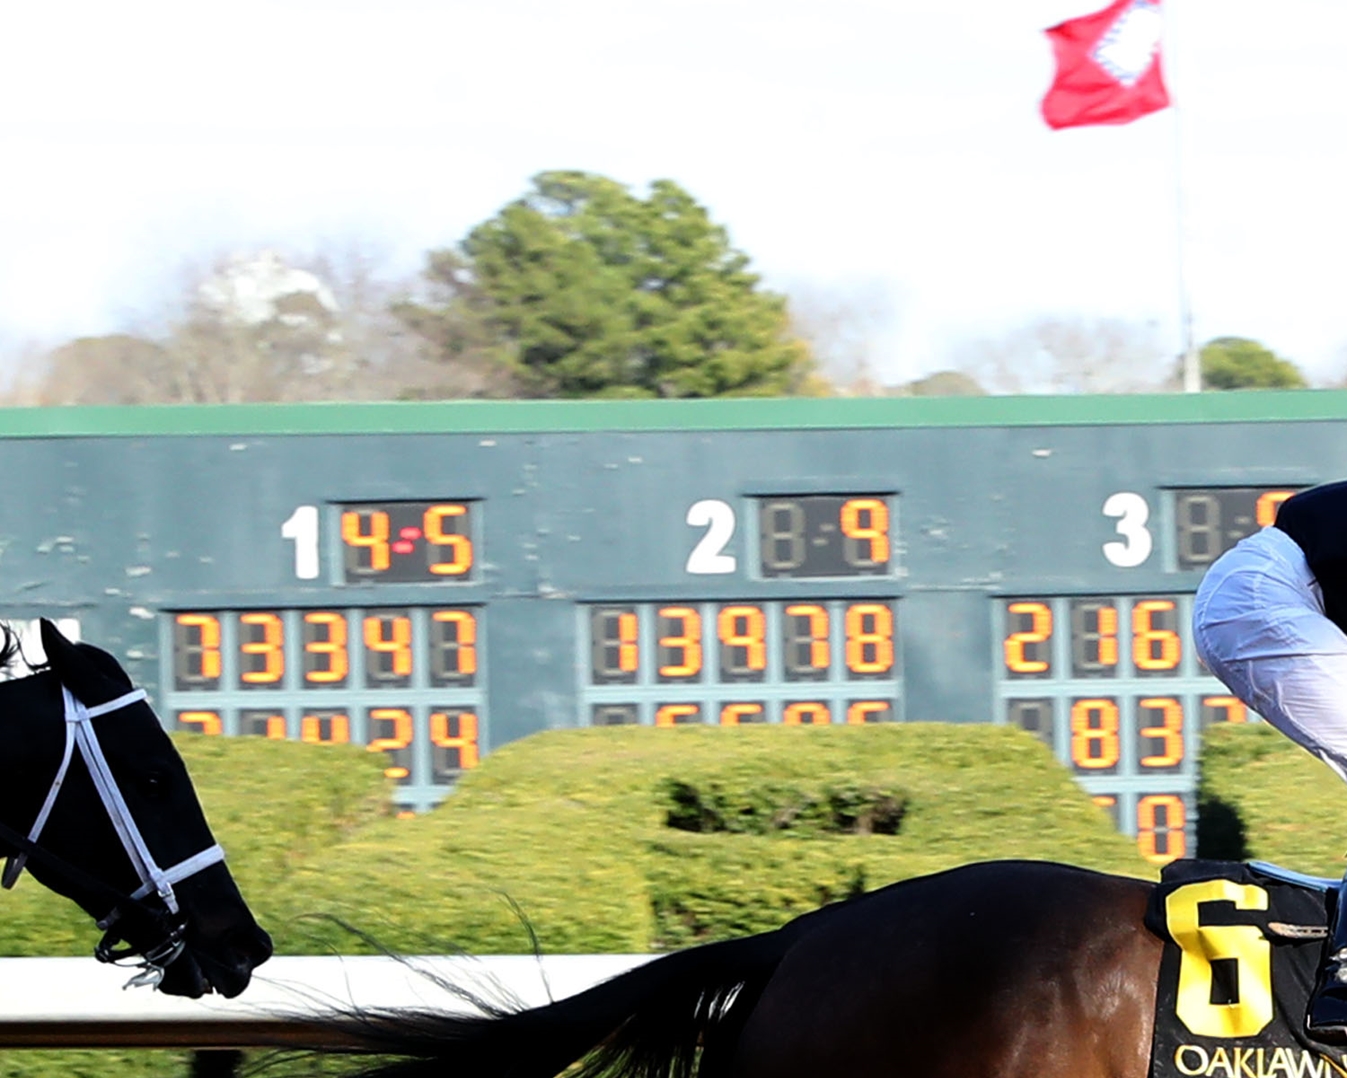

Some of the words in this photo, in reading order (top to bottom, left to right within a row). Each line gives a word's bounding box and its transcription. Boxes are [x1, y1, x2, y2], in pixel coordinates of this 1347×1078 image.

[281, 505, 319, 579] 1
[686, 499, 737, 574] 2
[840, 498, 890, 563] 9
[1102, 492, 1152, 567] 3
[618, 603, 894, 677] 13978
[1165, 879, 1274, 1038] 6
